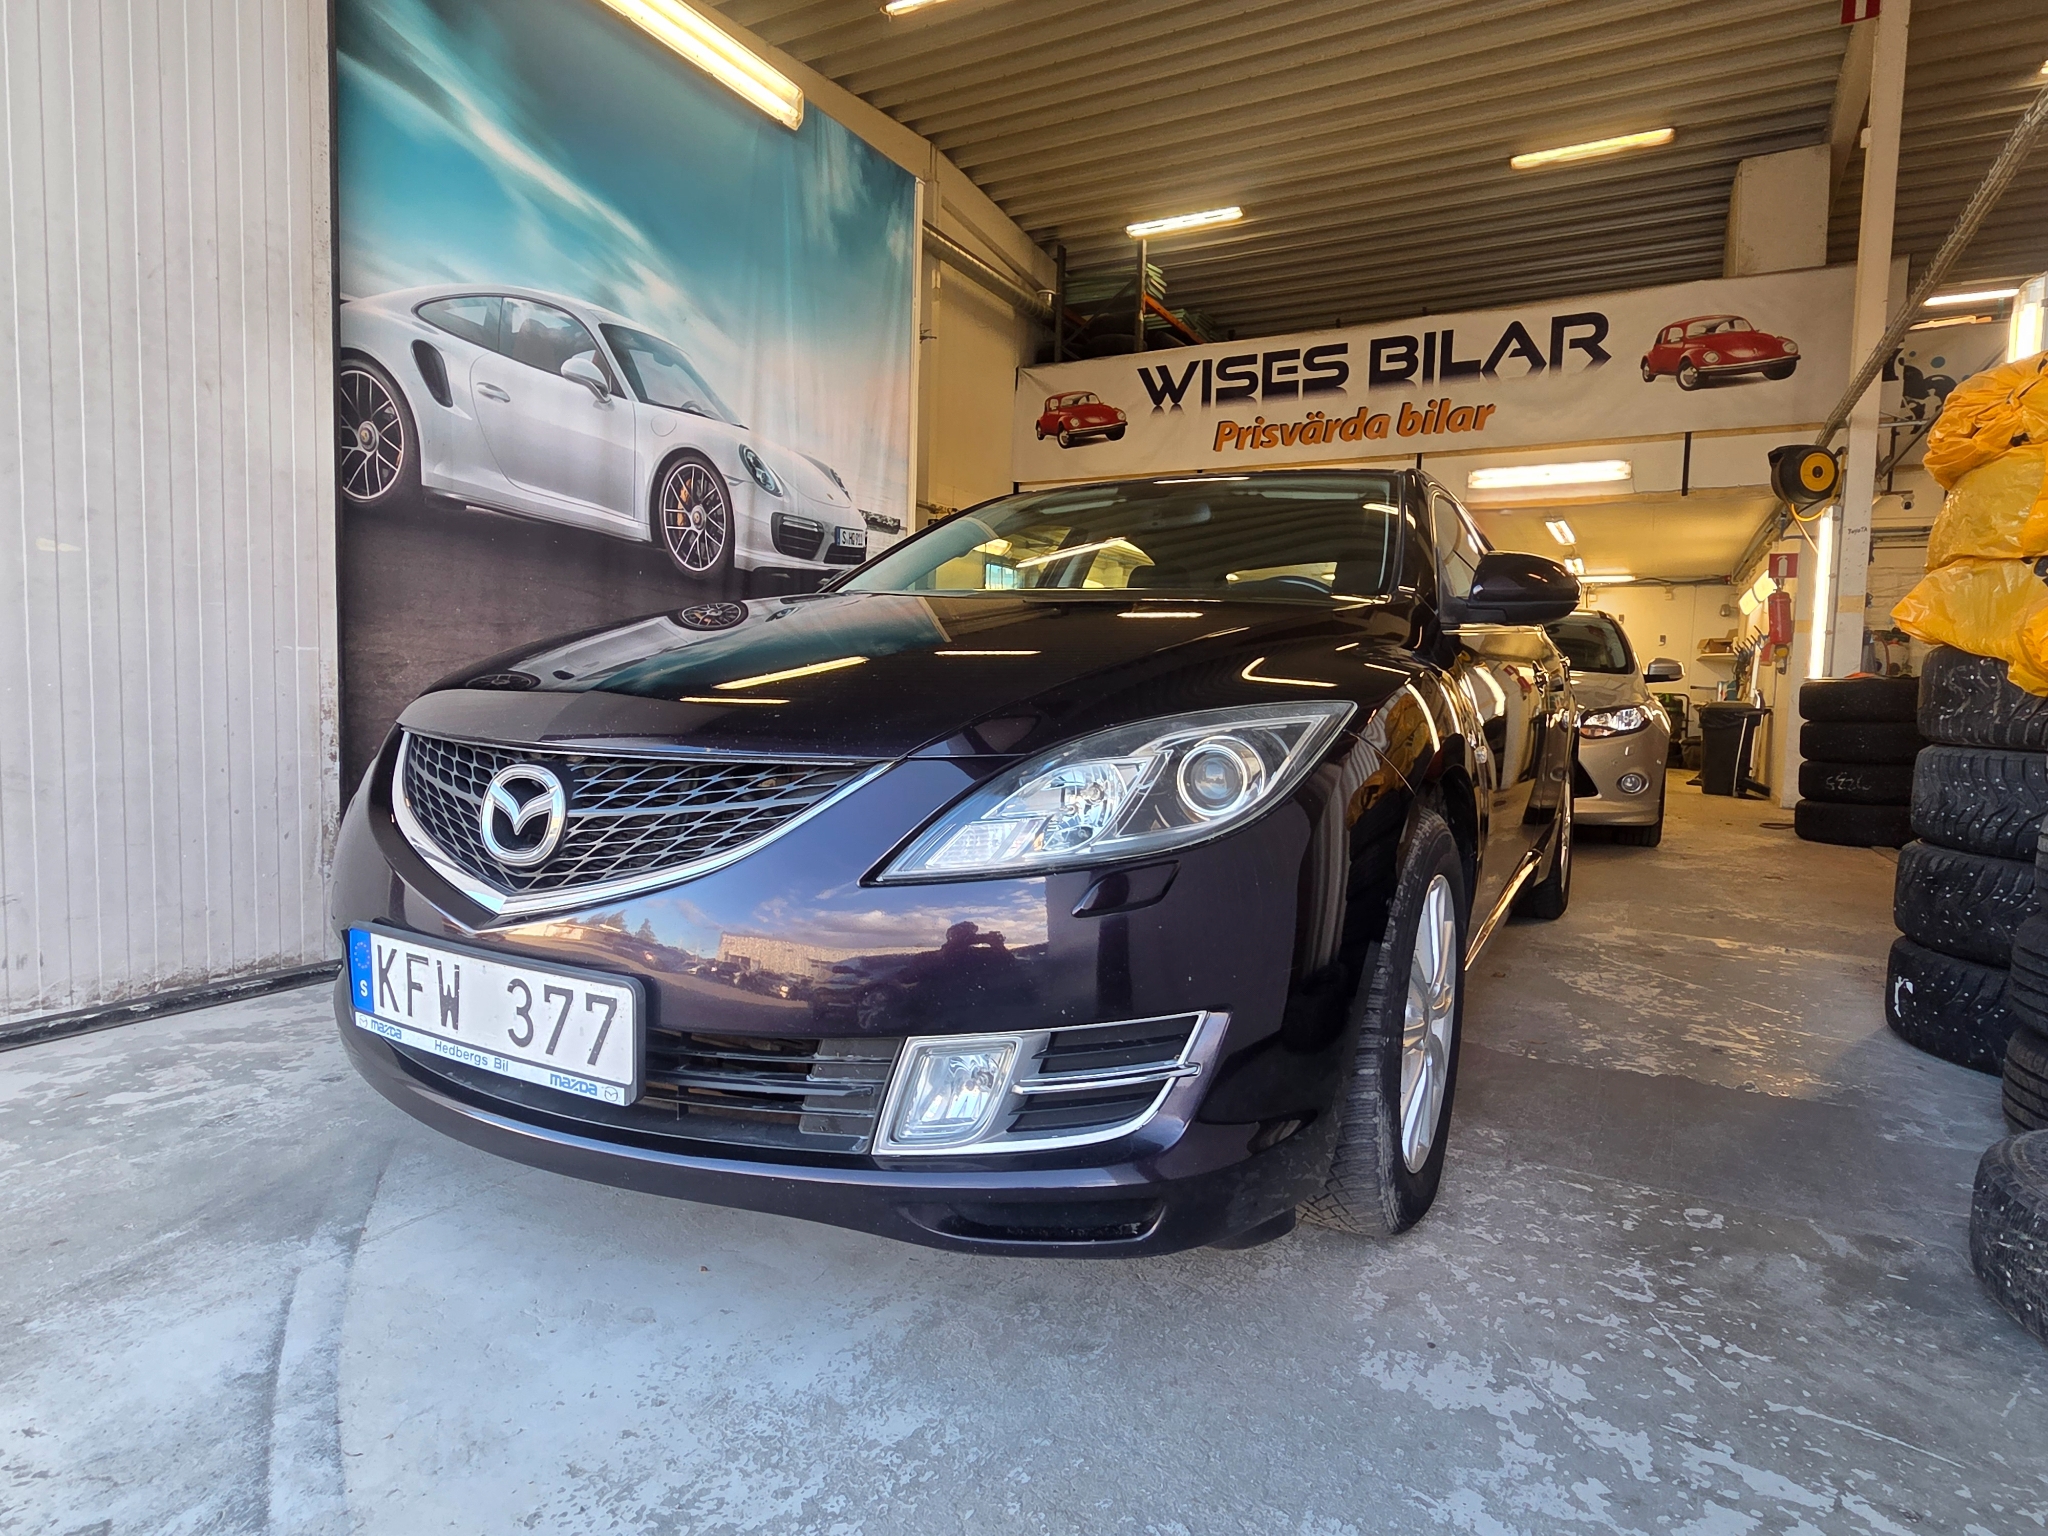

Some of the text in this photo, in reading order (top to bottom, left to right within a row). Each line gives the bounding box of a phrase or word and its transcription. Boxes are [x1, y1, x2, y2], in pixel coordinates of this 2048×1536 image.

[1137, 312, 1612, 407] WISES BILAR
[1213, 398, 1496, 452] Prisvärda bilar
[359, 979, 368, 997] S
[376, 944, 618, 1066] KFW 377
[434, 1040, 509, 1072] Hedbergs Bil
